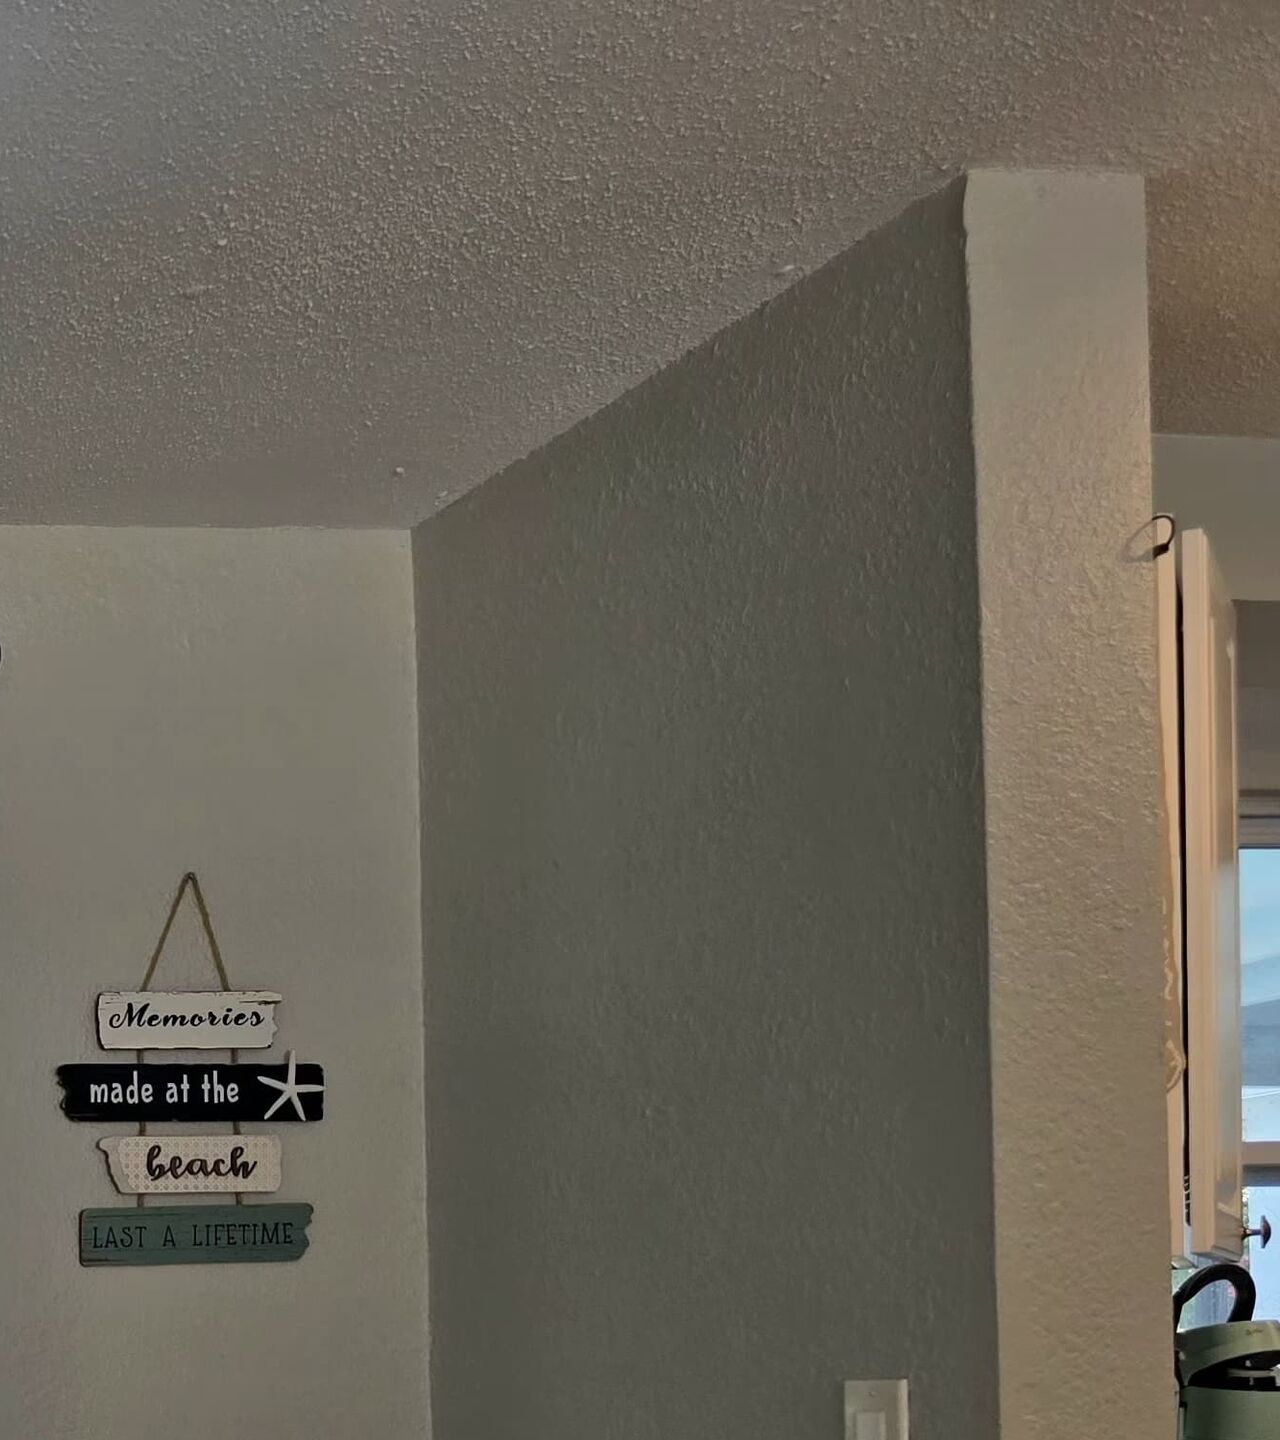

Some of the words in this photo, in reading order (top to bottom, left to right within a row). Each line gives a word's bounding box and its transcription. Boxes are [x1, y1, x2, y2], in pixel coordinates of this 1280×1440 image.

[108, 1001, 265, 1029] Memories
[89, 1070, 154, 1104] made
[165, 1073, 190, 1104] at
[201, 1070, 240, 1104] the
[145, 1144, 258, 1181] beach
[91, 1225, 148, 1249] LAST
[161, 1223, 177, 1248] A
[191, 1221, 295, 1248] LIFETIME
